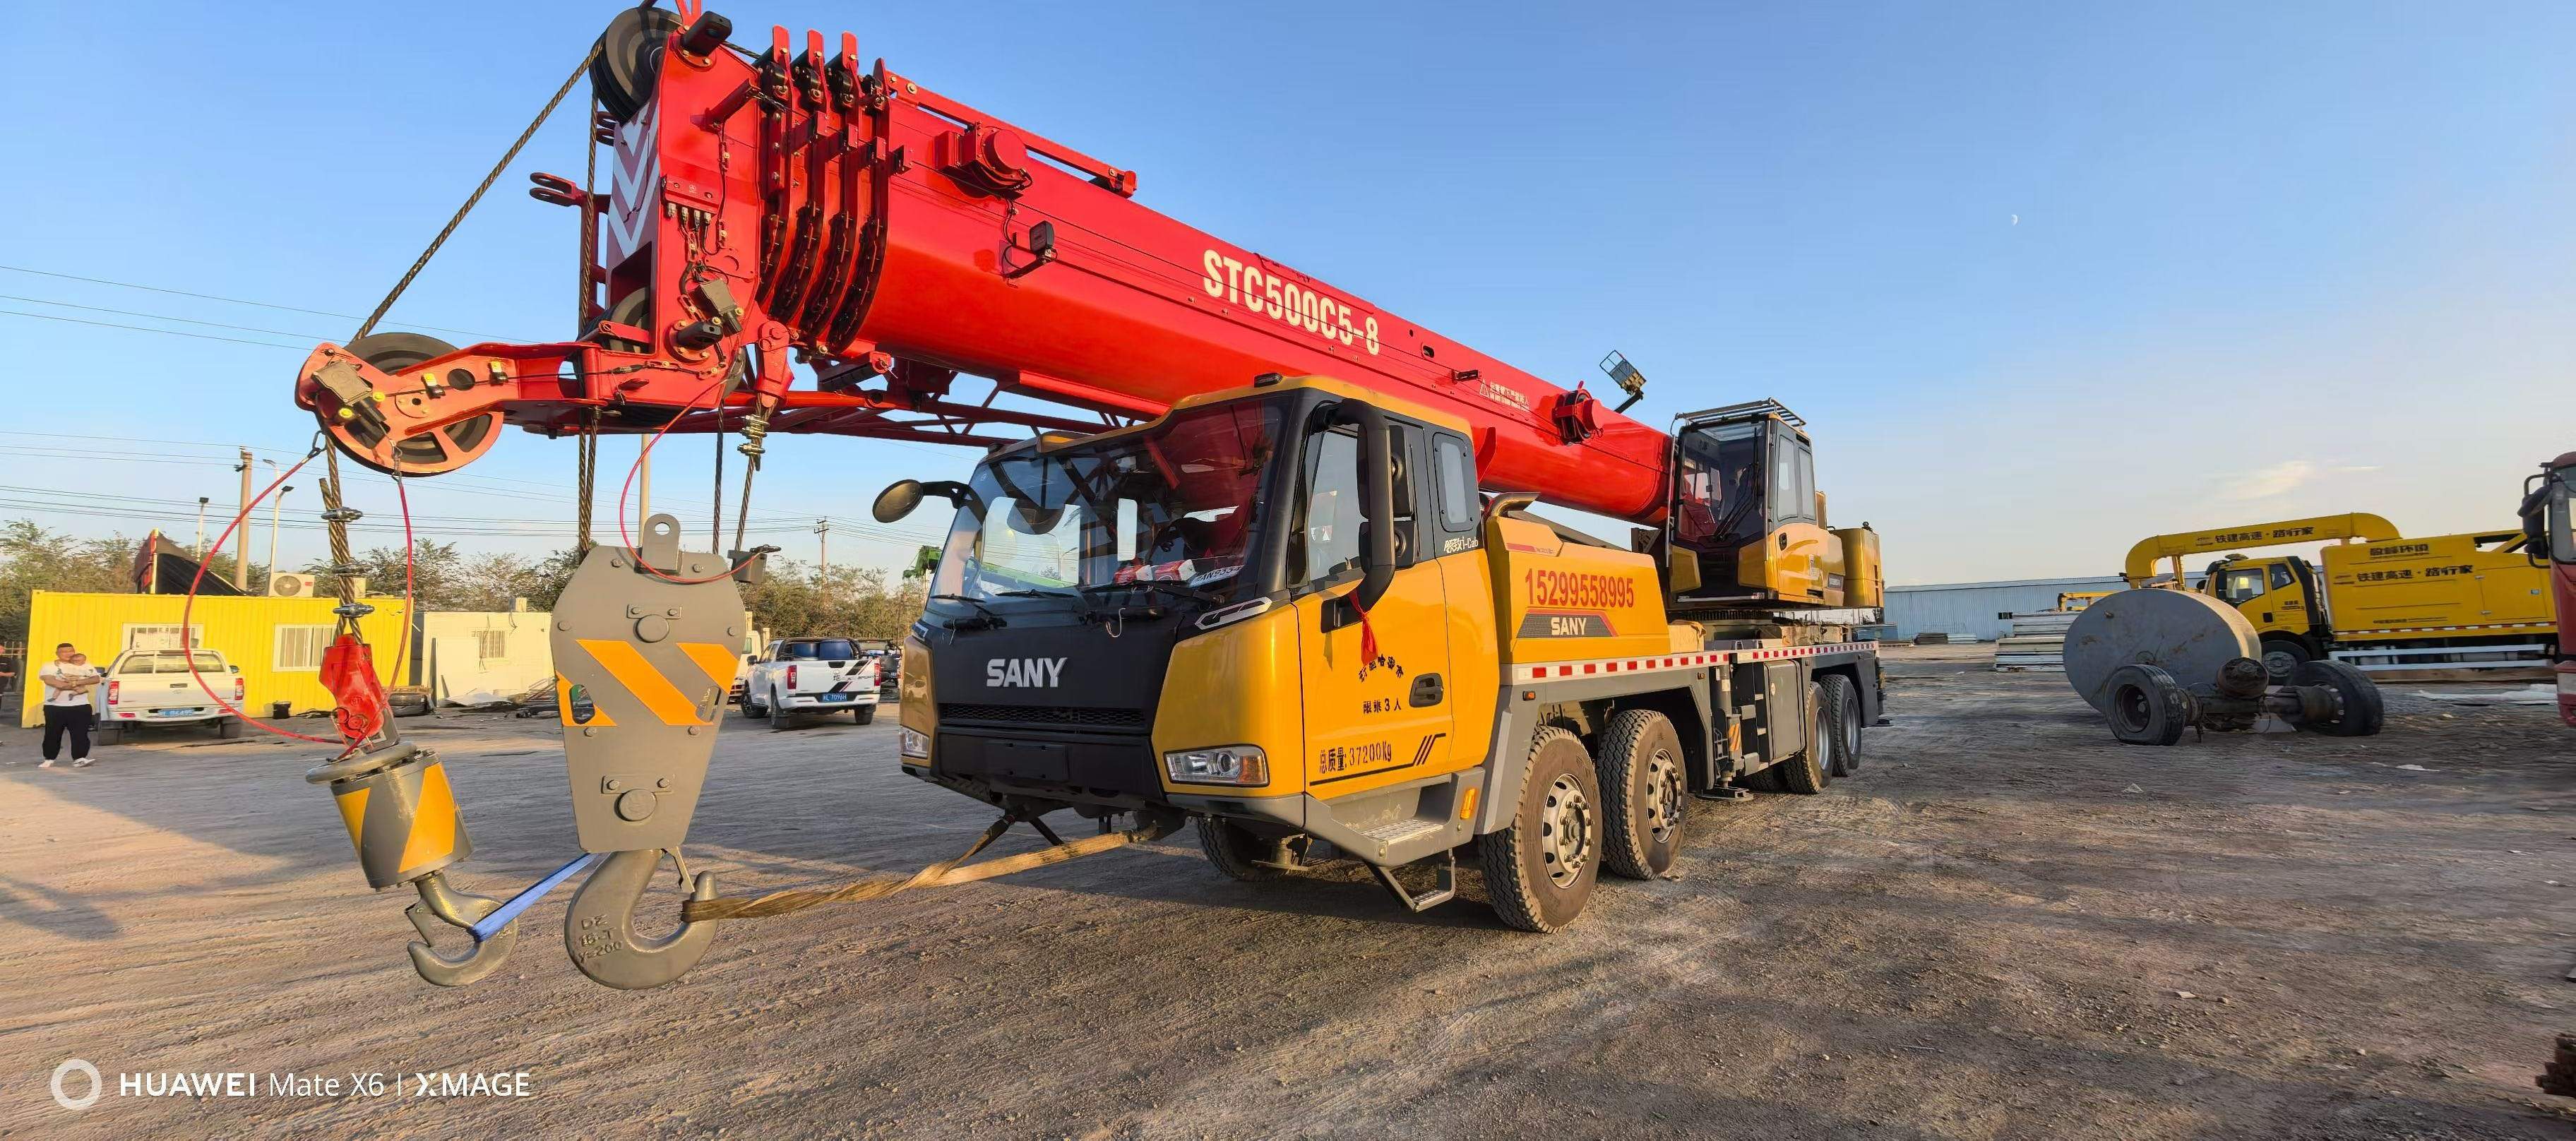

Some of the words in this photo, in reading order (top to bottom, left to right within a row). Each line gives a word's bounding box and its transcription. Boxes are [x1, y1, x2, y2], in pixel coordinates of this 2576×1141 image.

[1203, 249, 1380, 356] STC500C5-8
[1525, 568, 1635, 608] 15299558995
[1551, 616, 1587, 636] SANY
[986, 657, 1068, 688] SANY
